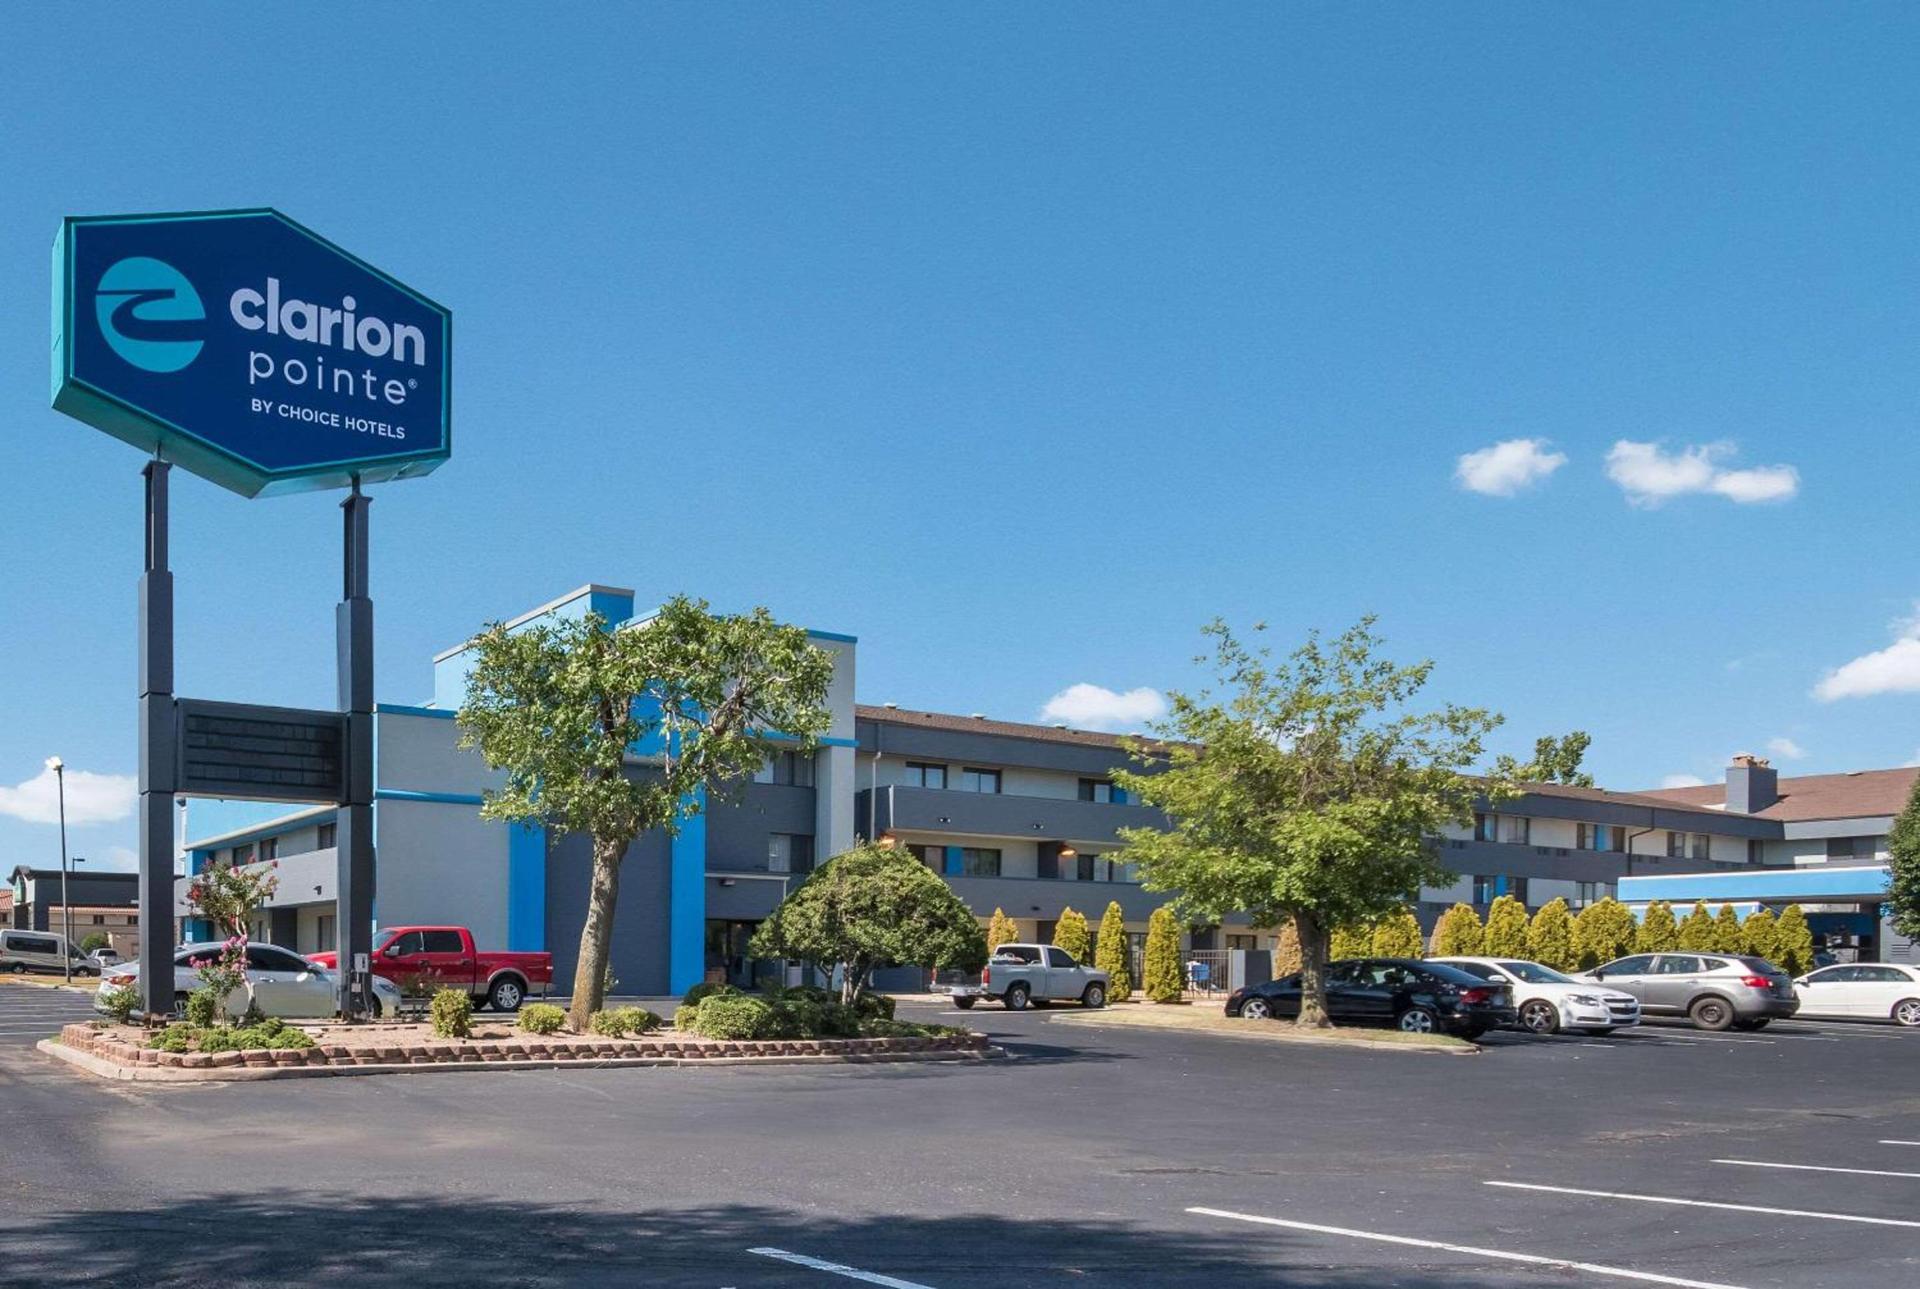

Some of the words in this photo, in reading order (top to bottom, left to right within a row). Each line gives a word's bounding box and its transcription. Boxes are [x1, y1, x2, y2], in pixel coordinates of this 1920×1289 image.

[229, 276, 425, 365] clarion
[251, 398, 273, 414] BY
[278, 403, 340, 427] CHOICE
[345, 416, 405, 439] HOTELS
